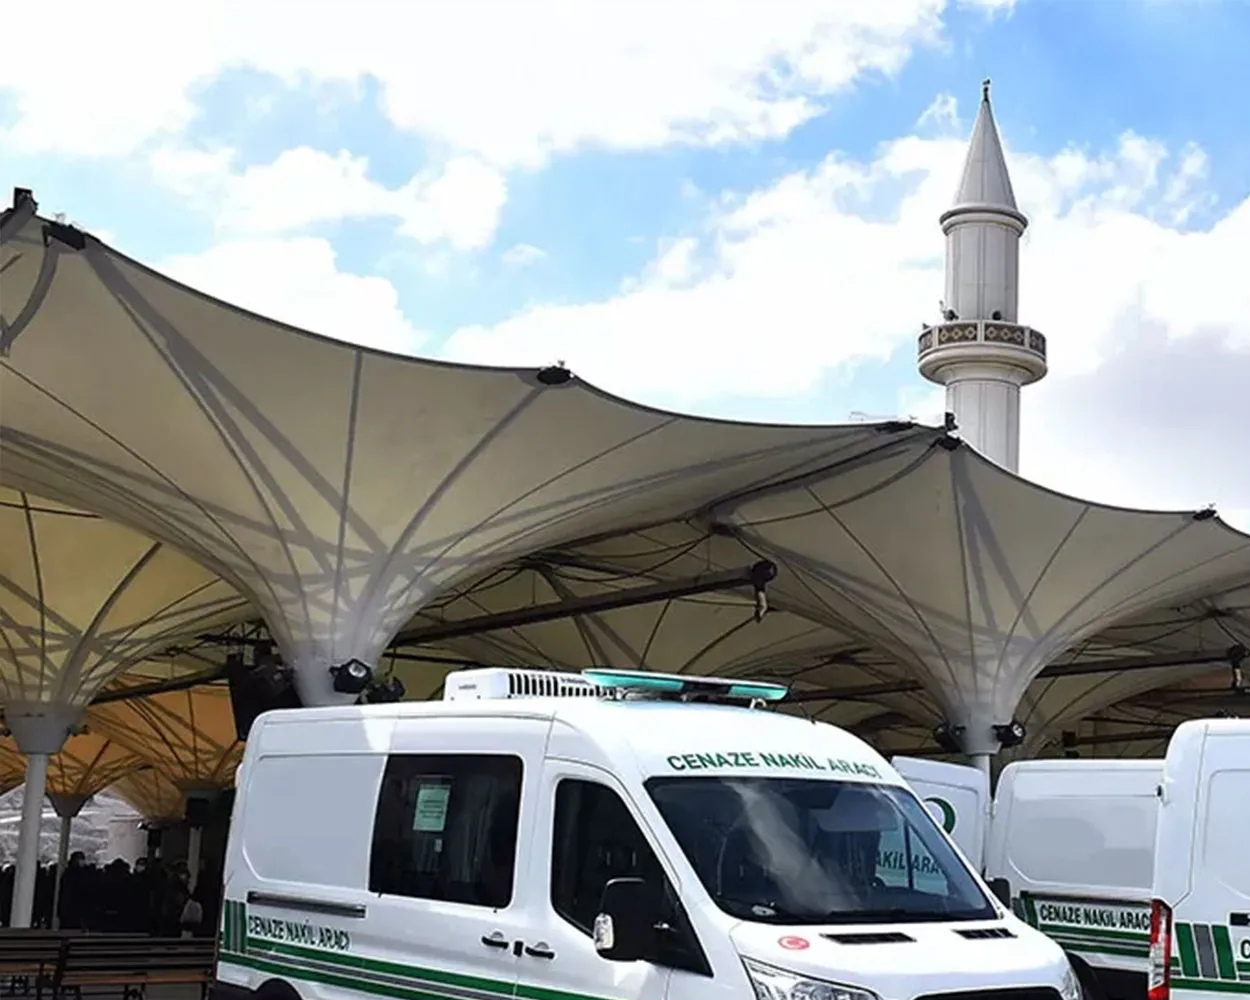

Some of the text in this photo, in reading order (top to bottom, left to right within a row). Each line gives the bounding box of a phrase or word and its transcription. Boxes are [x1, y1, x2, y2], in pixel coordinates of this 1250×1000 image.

[667, 752, 760, 771] CENAZE
[760, 752, 825, 770] NAKİL
[1040, 904, 1081, 924] CENAZE
